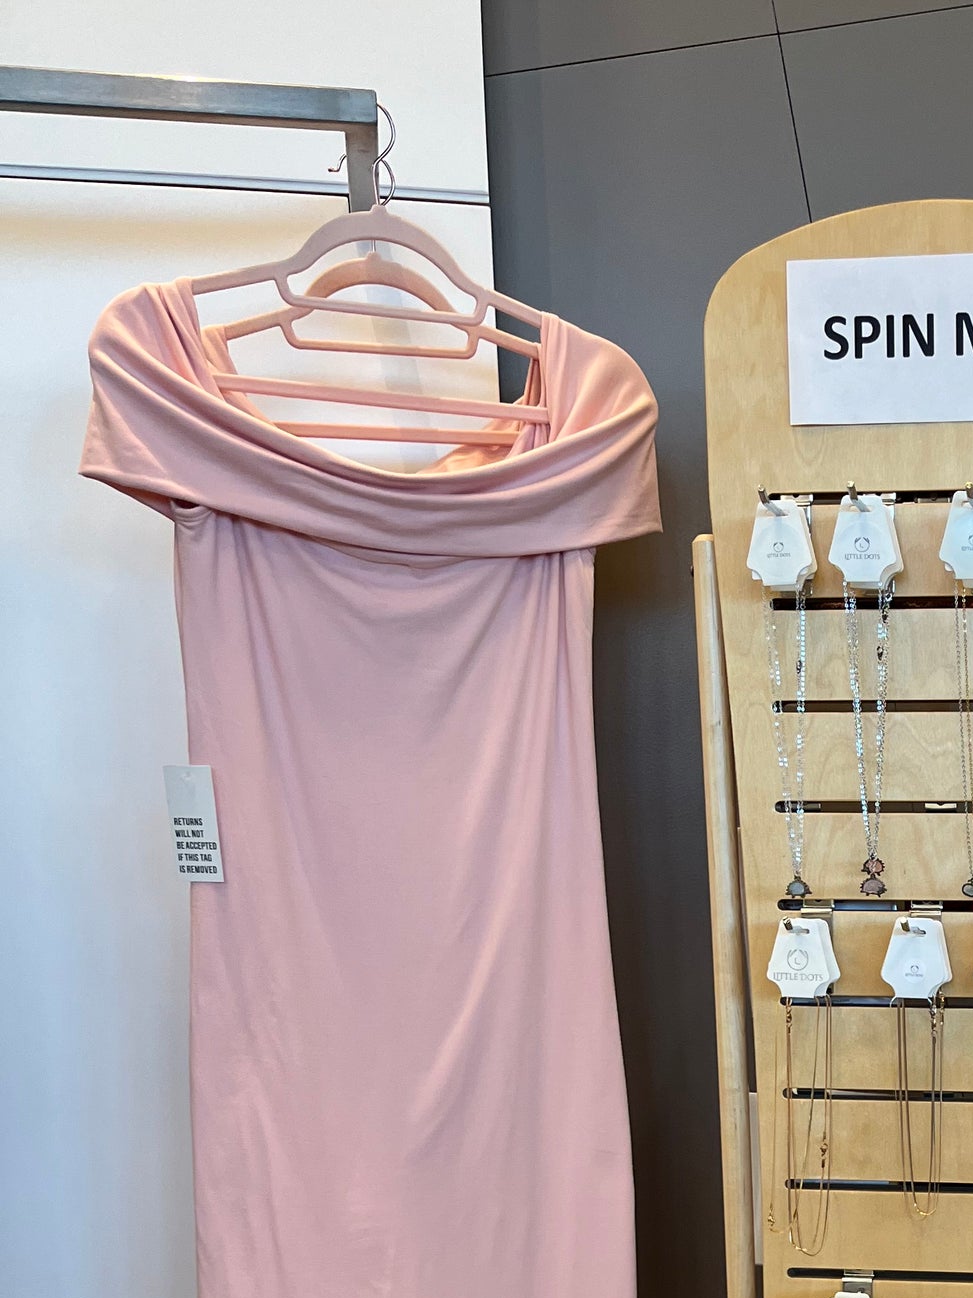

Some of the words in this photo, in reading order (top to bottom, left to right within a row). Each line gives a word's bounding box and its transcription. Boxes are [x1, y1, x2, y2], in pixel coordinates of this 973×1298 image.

[823, 313, 935, 360] SPIN
[173, 817, 203, 826] RETURNS
[175, 830, 191, 838] WILL
[191, 829, 204, 838] NOT
[176, 841, 184, 850] BE
[186, 841, 217, 850] ACCEPTED
[178, 853, 184, 861] IF
[184, 853, 199, 861] THIS
[200, 853, 212, 861] TAG
[179, 865, 186, 873] IS
[187, 865, 218, 874] REMOVED
[773, 972, 798, 981] LITTLE
[800, 972, 824, 981] DOTS
